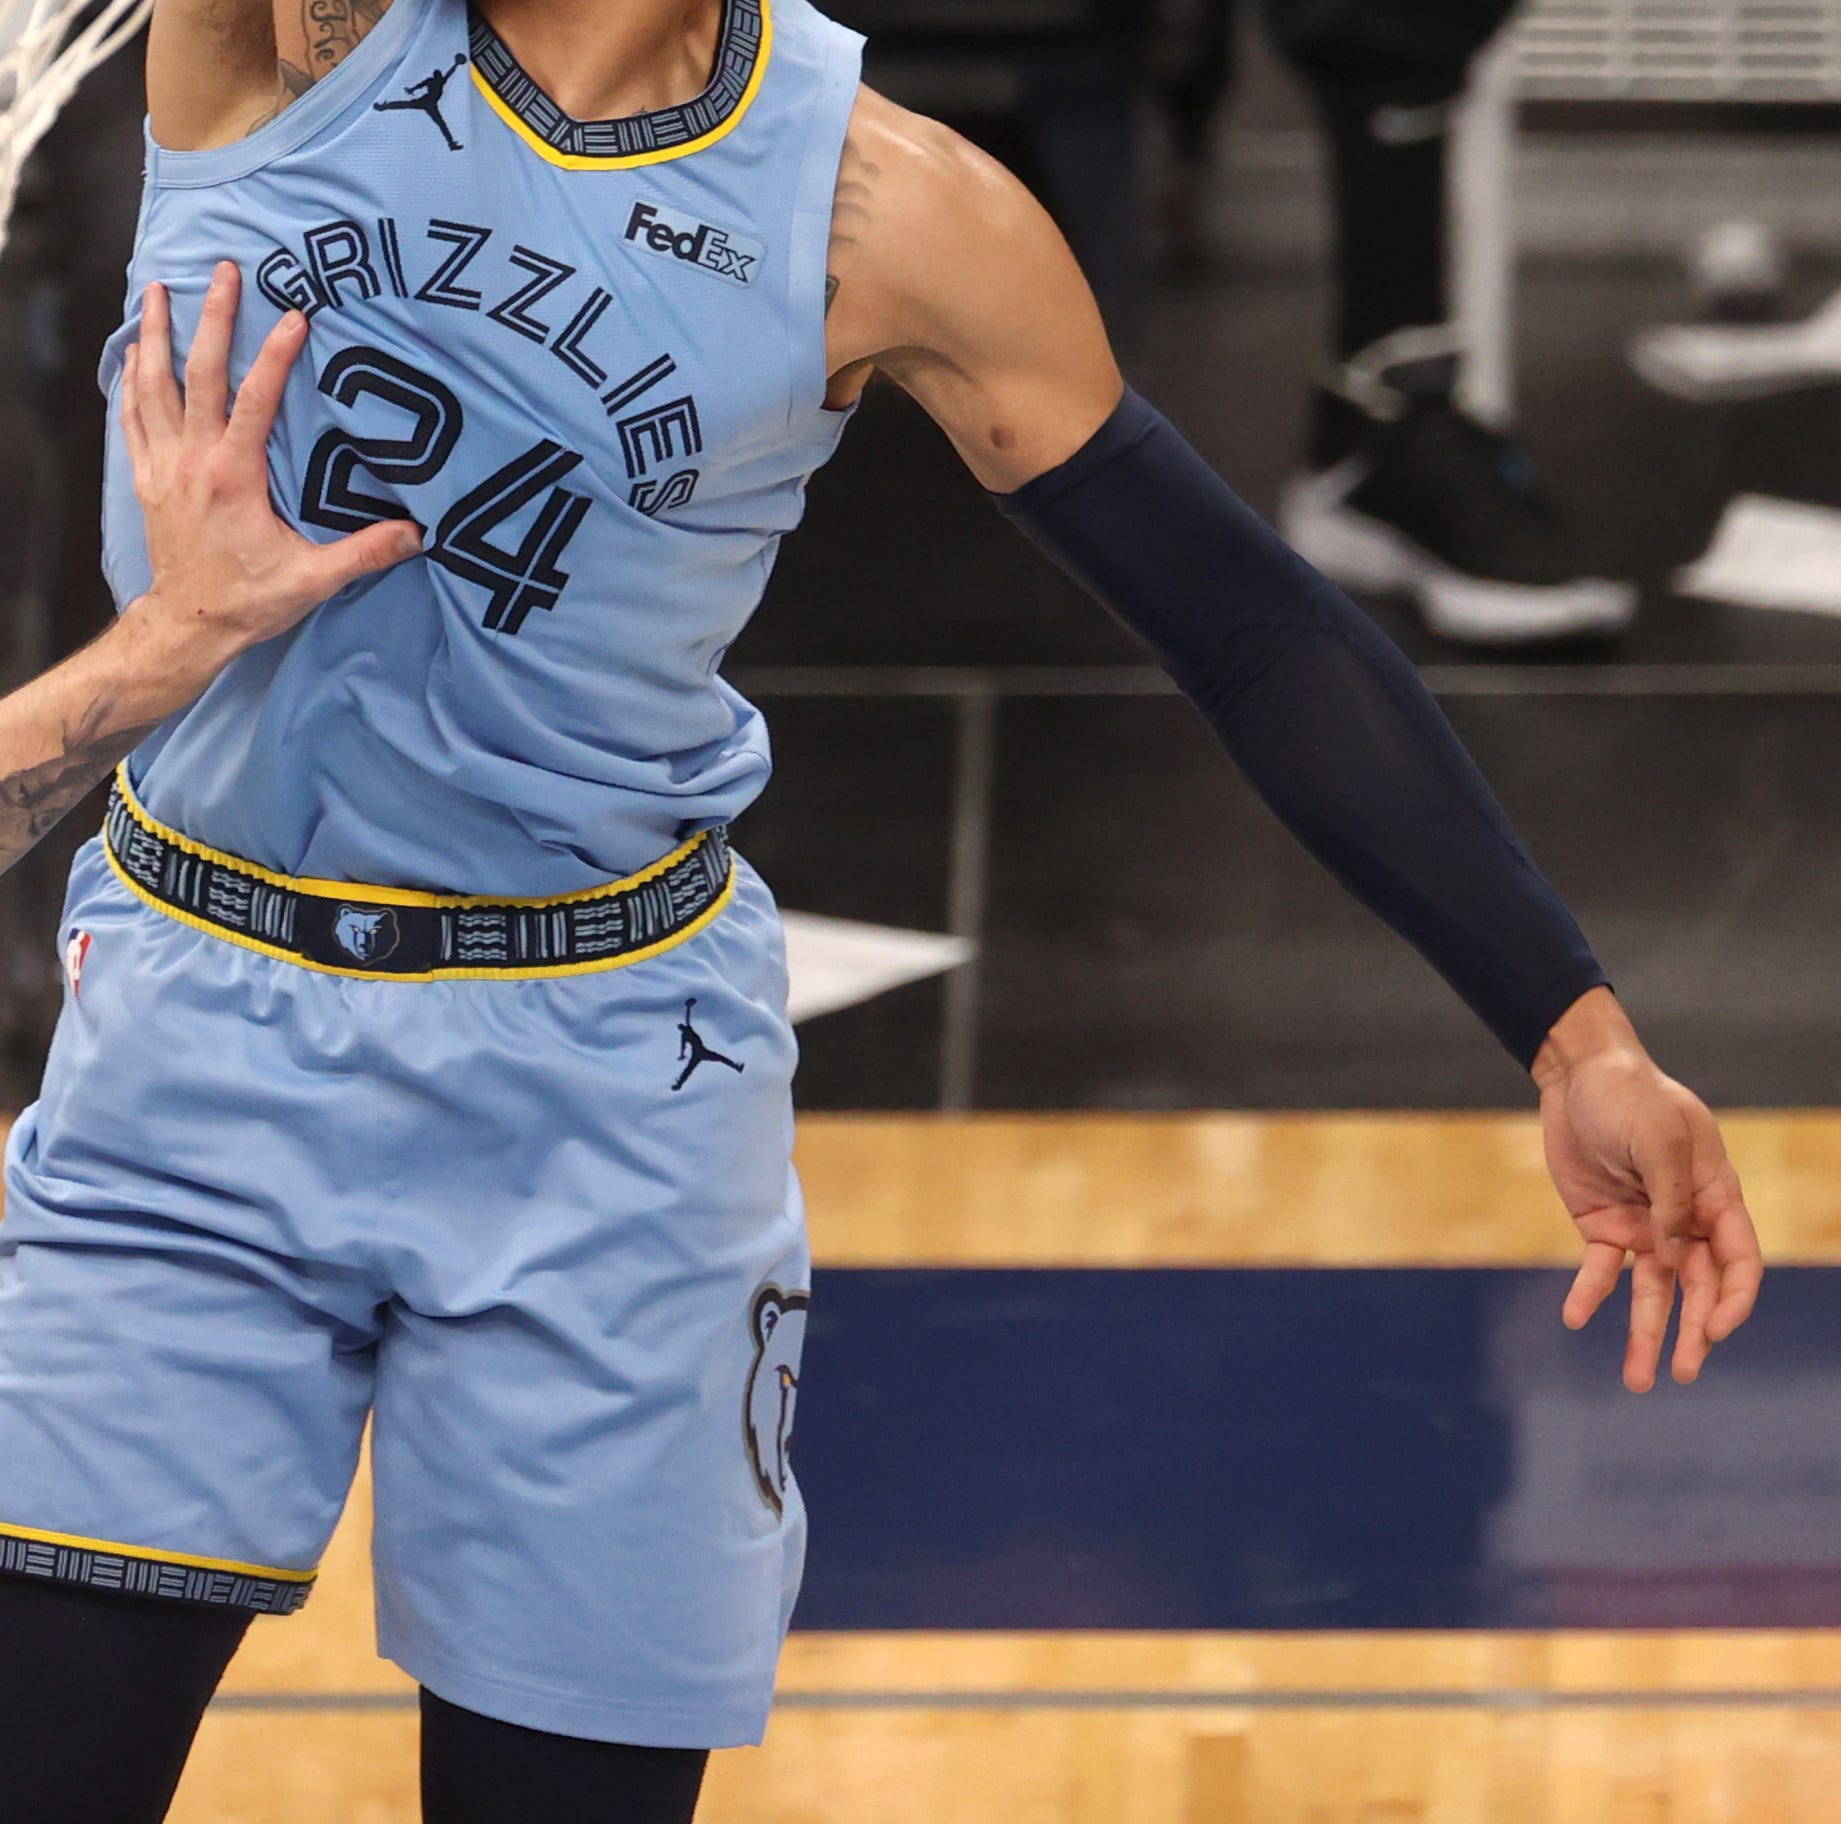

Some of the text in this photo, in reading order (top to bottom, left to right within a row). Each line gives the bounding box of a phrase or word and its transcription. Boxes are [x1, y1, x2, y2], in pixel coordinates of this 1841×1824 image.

[256, 217, 704, 517] GRIZZLIES
[624, 201, 757, 284] FedEx
[299, 344, 594, 636] 24
